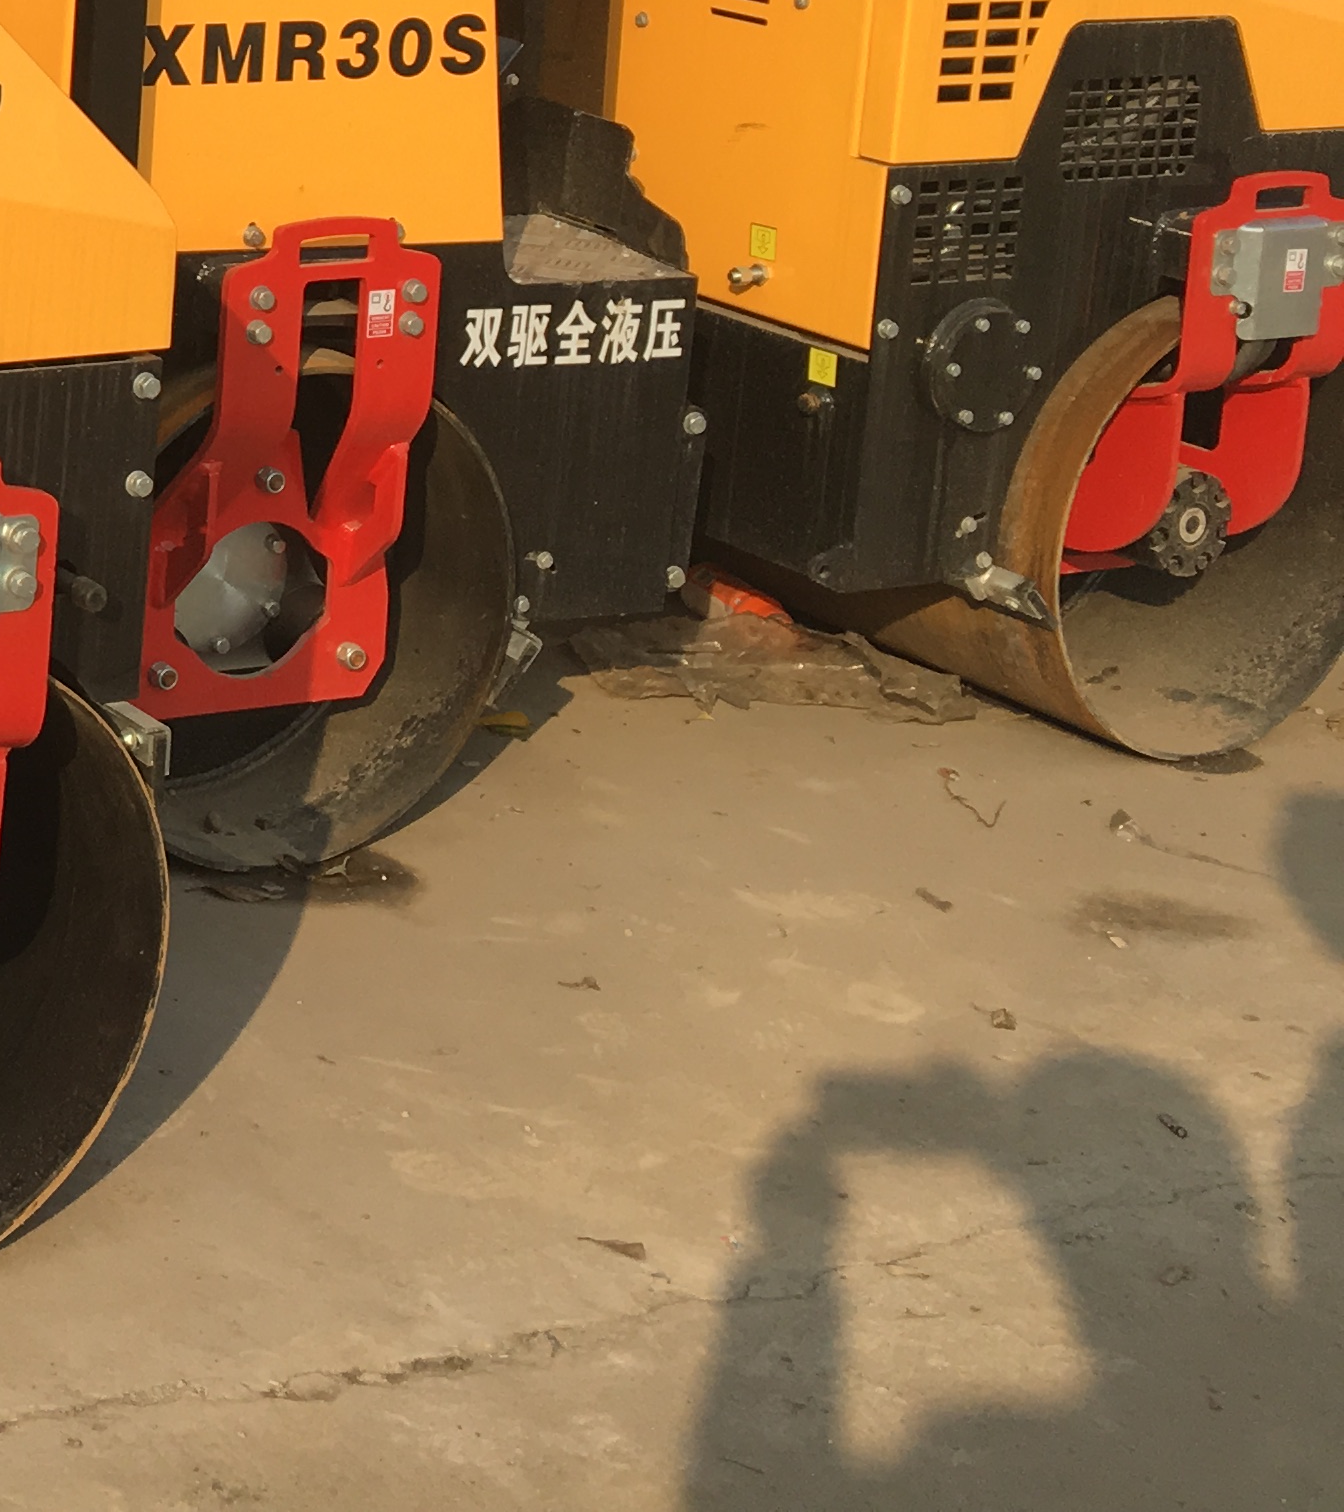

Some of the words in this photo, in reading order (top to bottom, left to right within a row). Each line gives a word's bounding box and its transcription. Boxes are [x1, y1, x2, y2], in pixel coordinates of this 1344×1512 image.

[143, 14, 486, 86] XMR30S
[459, 297, 687, 368] 双驱全液压
